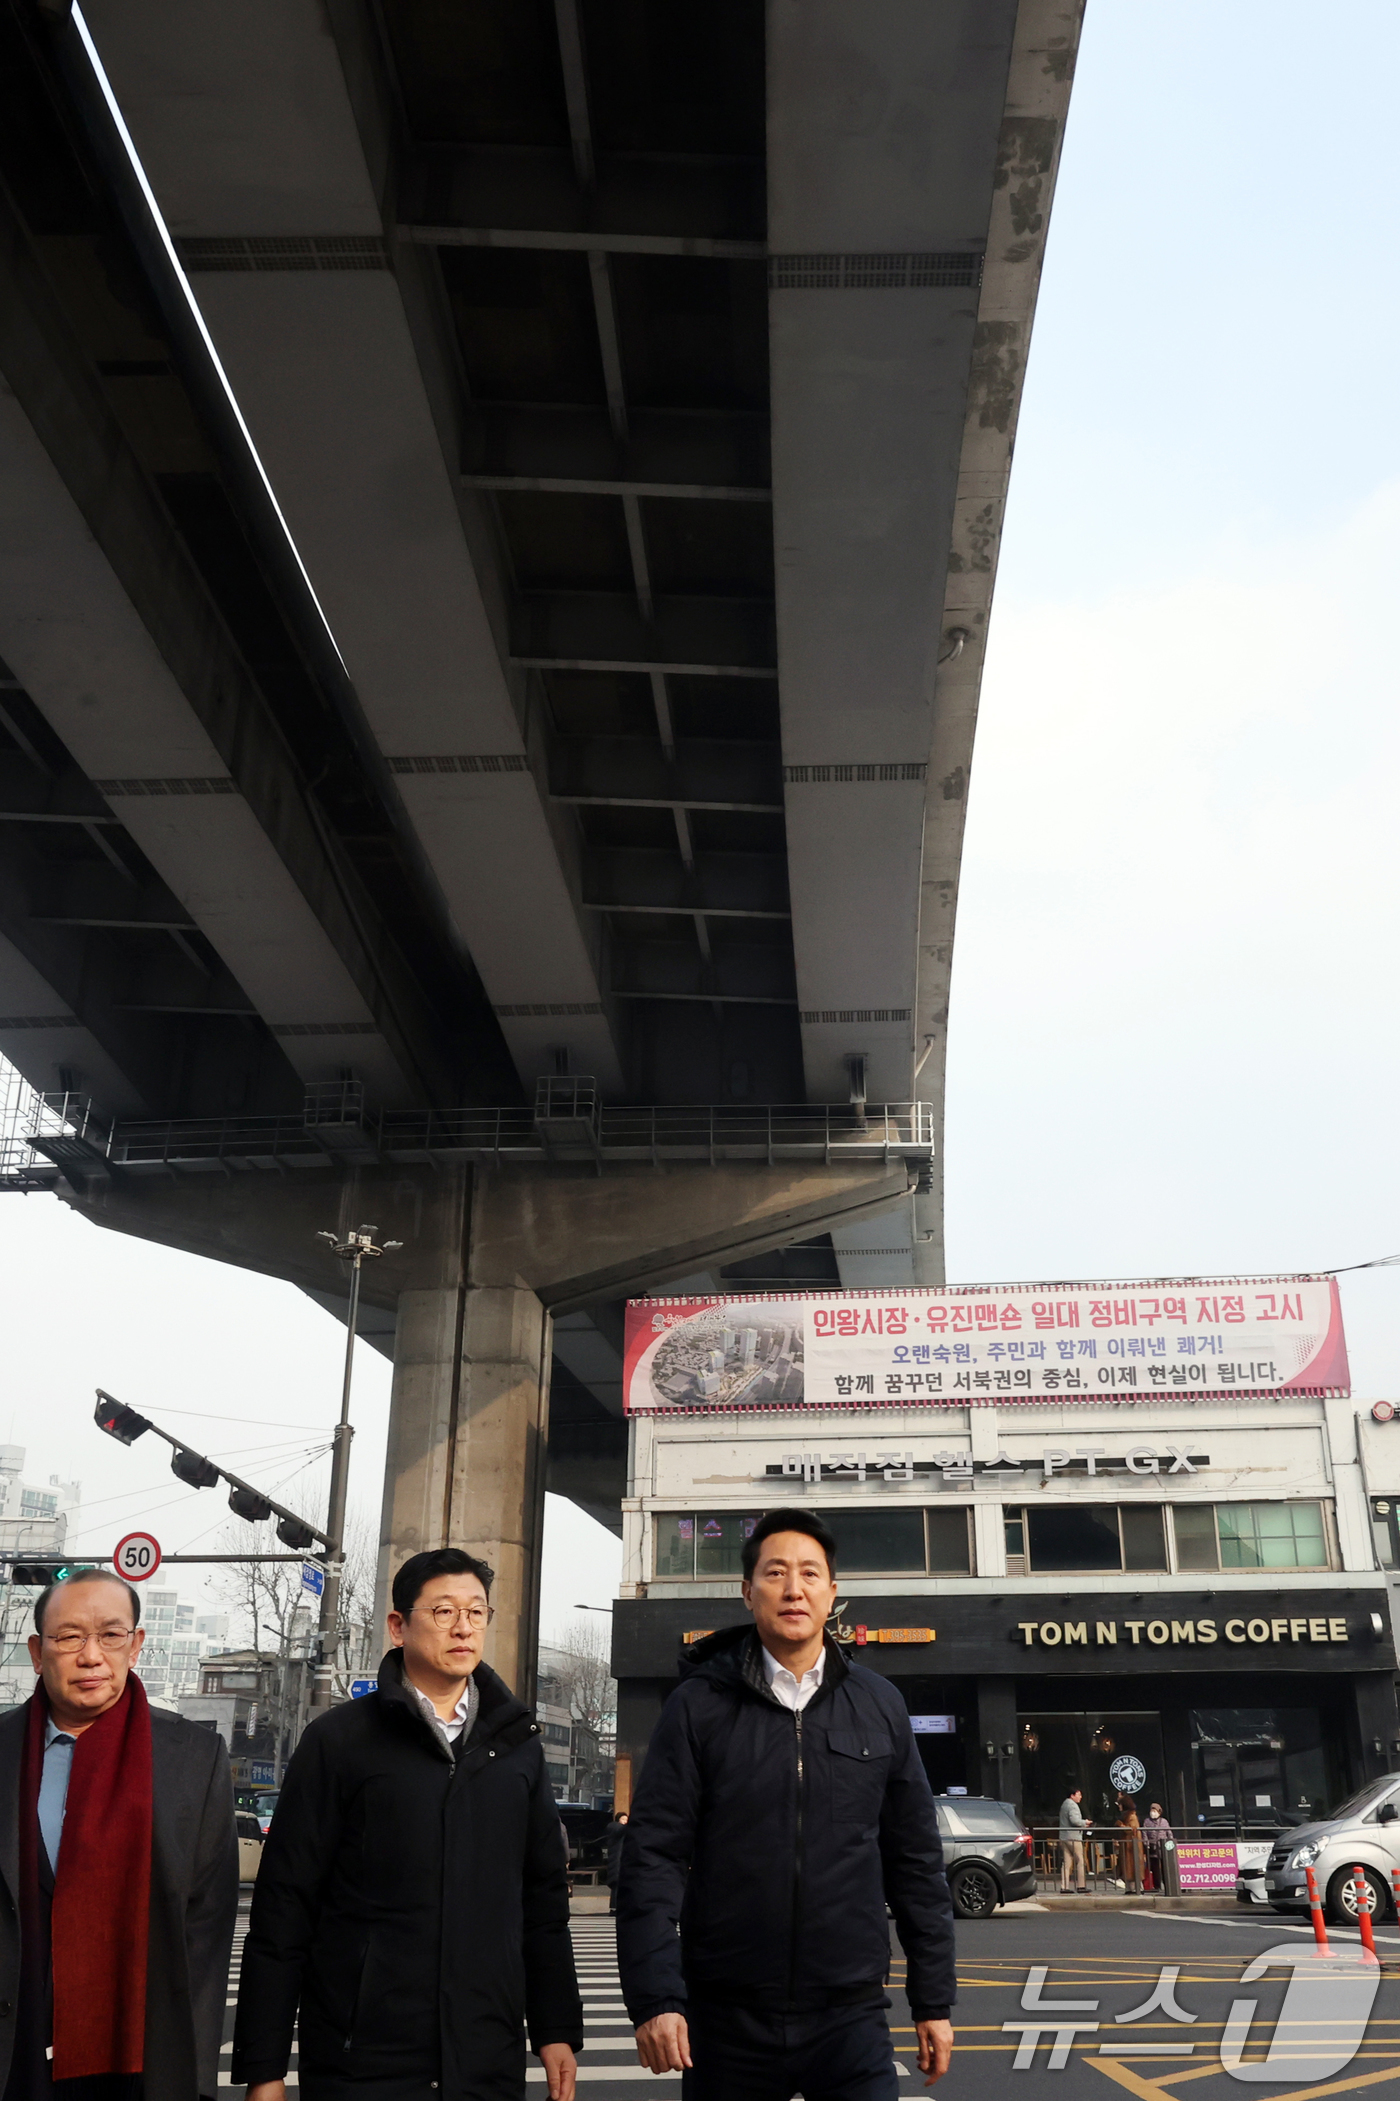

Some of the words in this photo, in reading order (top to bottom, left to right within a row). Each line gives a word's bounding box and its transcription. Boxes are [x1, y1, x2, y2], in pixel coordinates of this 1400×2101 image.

[813, 1302, 1022, 1338] 인왕시장·유진맨숀
[1031, 1299, 1080, 1329] 일대
[1088, 1297, 1188, 1328] 정비구역
[1195, 1295, 1246, 1324] 지정
[1255, 1293, 1304, 1322] 고시
[891, 1342, 978, 1365] 오랜숙원,
[986, 1340, 1047, 1362] 주민과
[1056, 1338, 1097, 1360] 함께
[1107, 1336, 1167, 1358] 이뤄낸
[1176, 1334, 1224, 1355] 쾌거!
[834, 1373, 874, 1395] 함께
[884, 1371, 943, 1394] 꿈꾸던
[952, 1368, 1032, 1391] 서북권의
[1041, 1367, 1088, 1389] 중심,
[1097, 1365, 1137, 1387] 이제
[1148, 1363, 1207, 1385] 현실이
[1216, 1361, 1284, 1382] 됩니다.
[781, 1451, 914, 1482] 매직짐
[932, 1450, 1025, 1481] 헬스
[1042, 1447, 1106, 1476] PT
[1125, 1445, 1199, 1474] GX
[124, 1546, 151, 1568] 50
[1018, 1621, 1088, 1646] TOM
[1096, 1620, 1118, 1645] N
[1124, 1619, 1218, 1645] TOMS
[1224, 1617, 1349, 1643] COFFEE
[1112, 1759, 1124, 1775] TOM
[1129, 1758, 1144, 1778] TOMS
[1113, 1777, 1142, 1791] COFFEE
[1202, 1847, 1235, 1858] 광고문의
[1180, 1873, 1236, 1884] 02.712.0098
